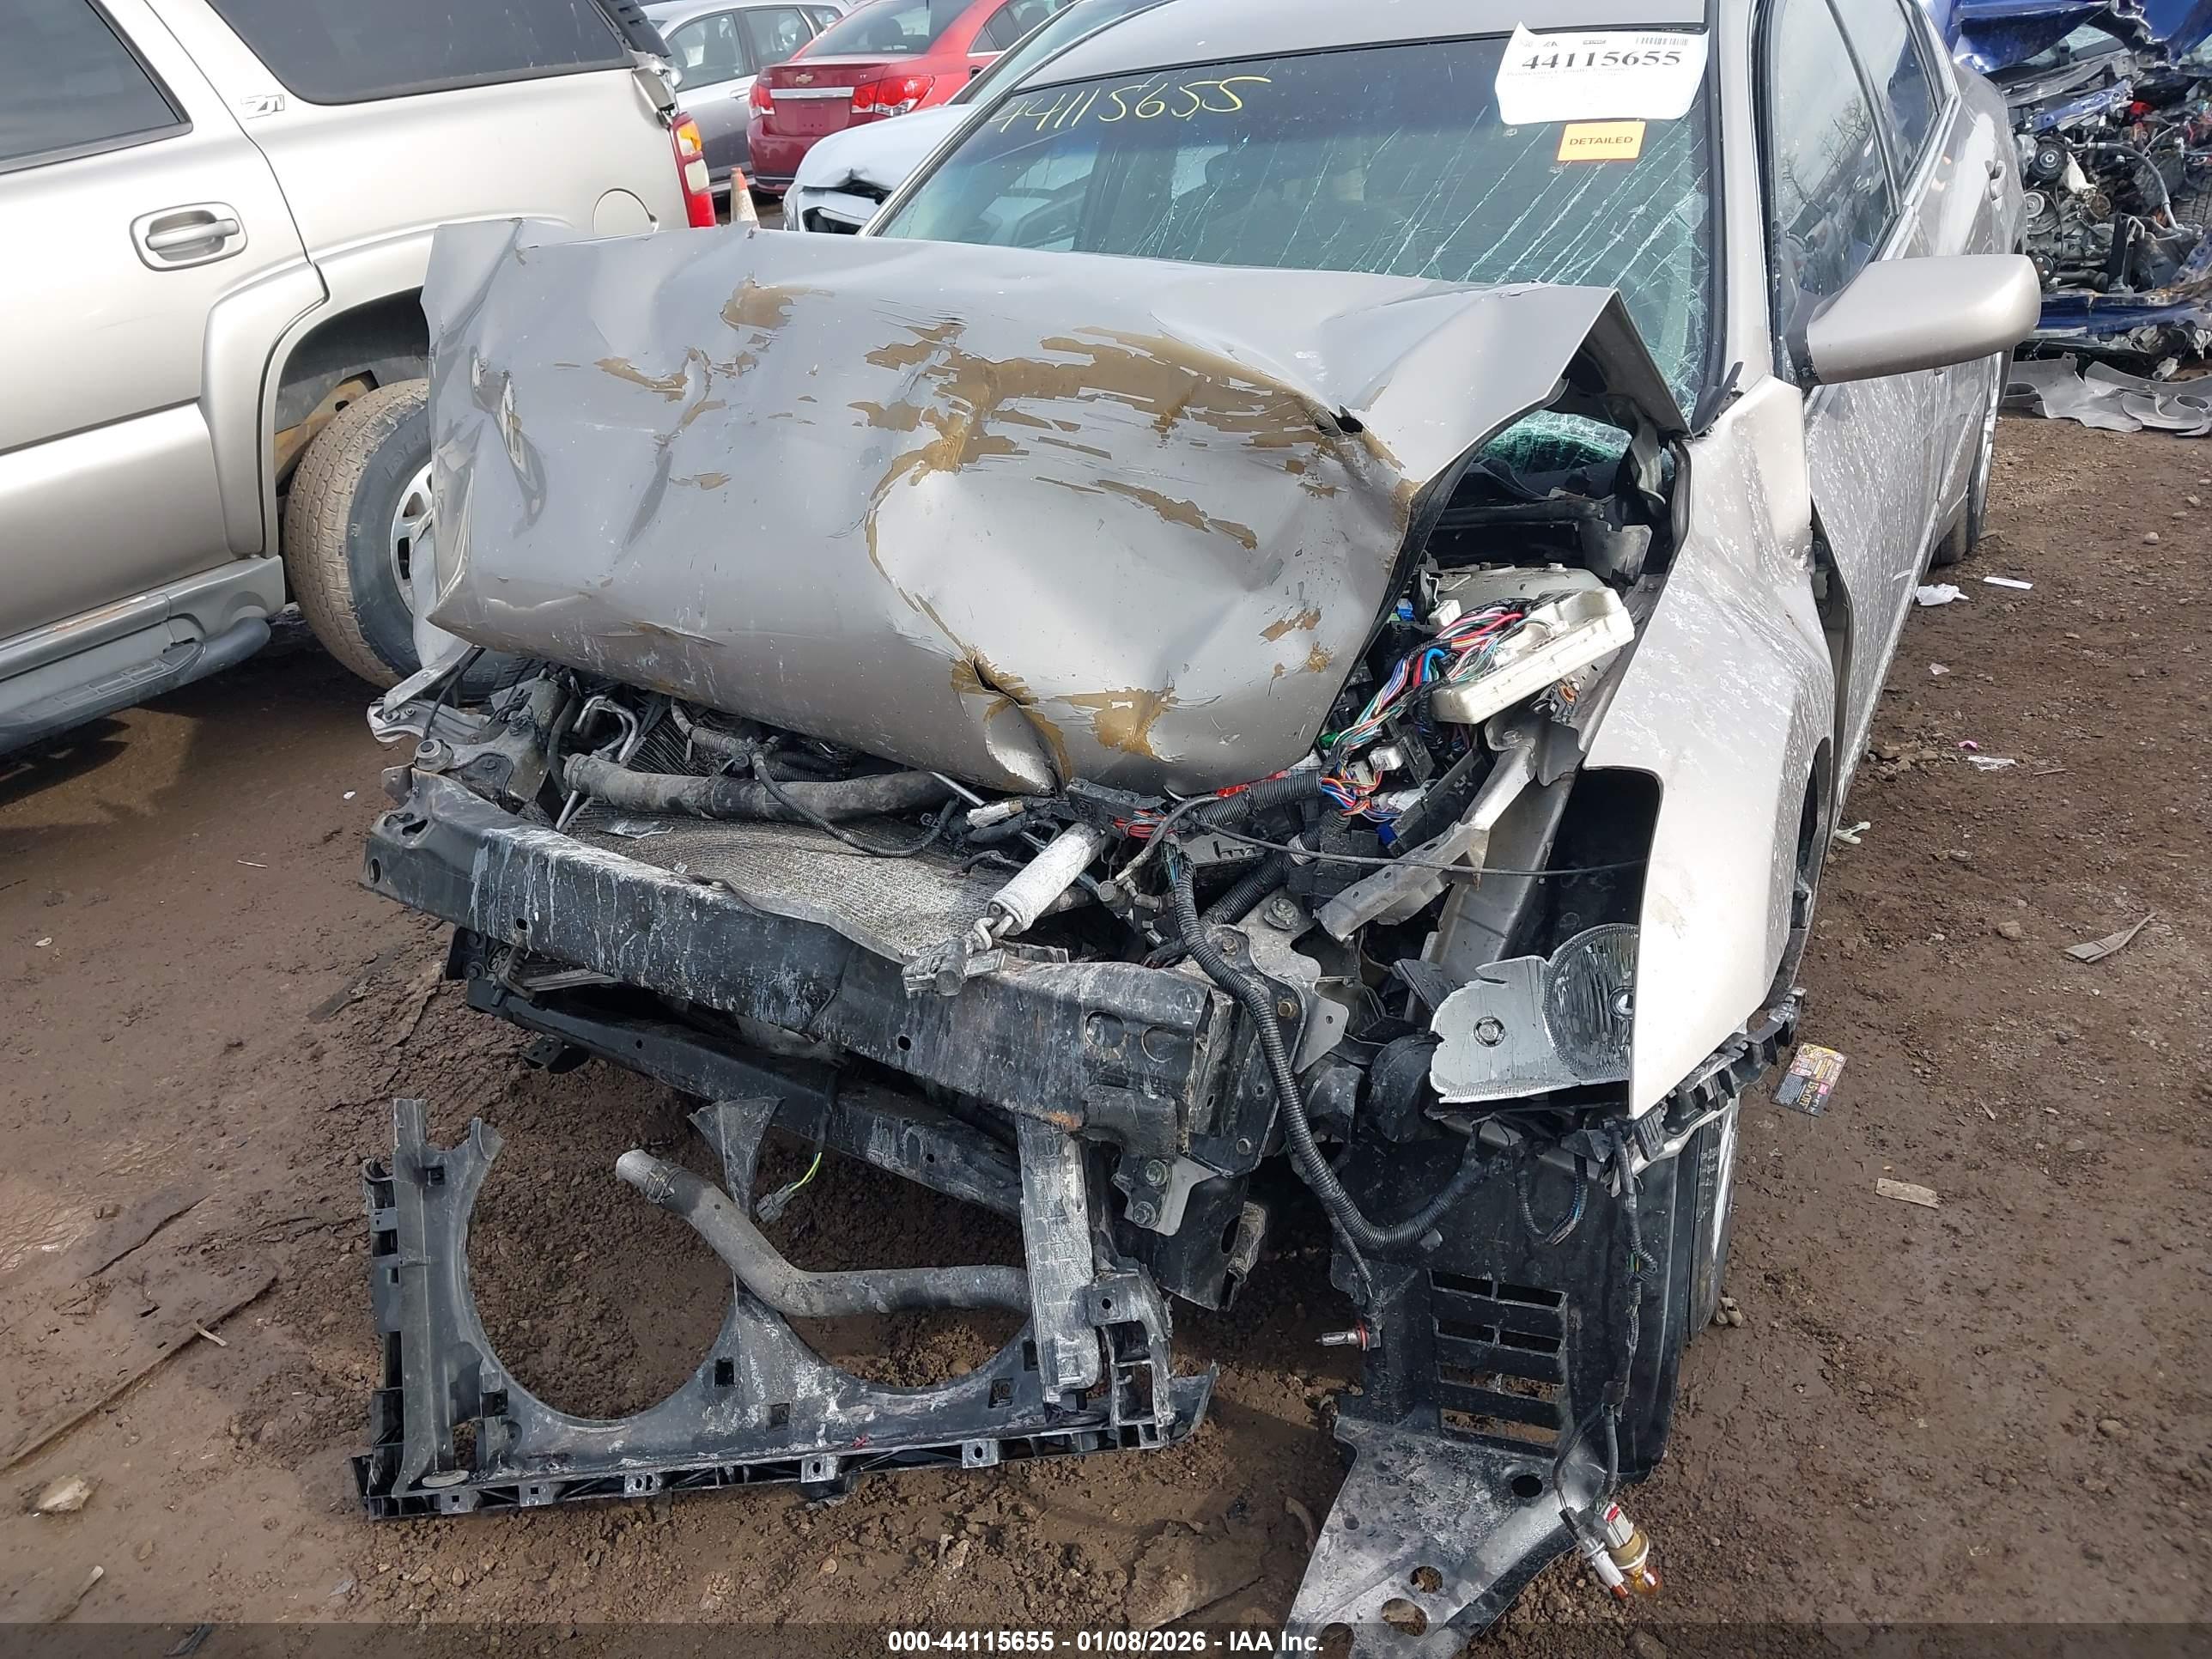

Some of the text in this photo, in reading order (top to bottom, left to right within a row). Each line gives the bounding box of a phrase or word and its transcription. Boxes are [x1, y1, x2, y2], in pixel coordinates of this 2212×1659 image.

[1522, 51, 1682, 70] 44115655
[989, 76, 1272, 133] 44115655
[1570, 136, 1633, 145] DETAILED
